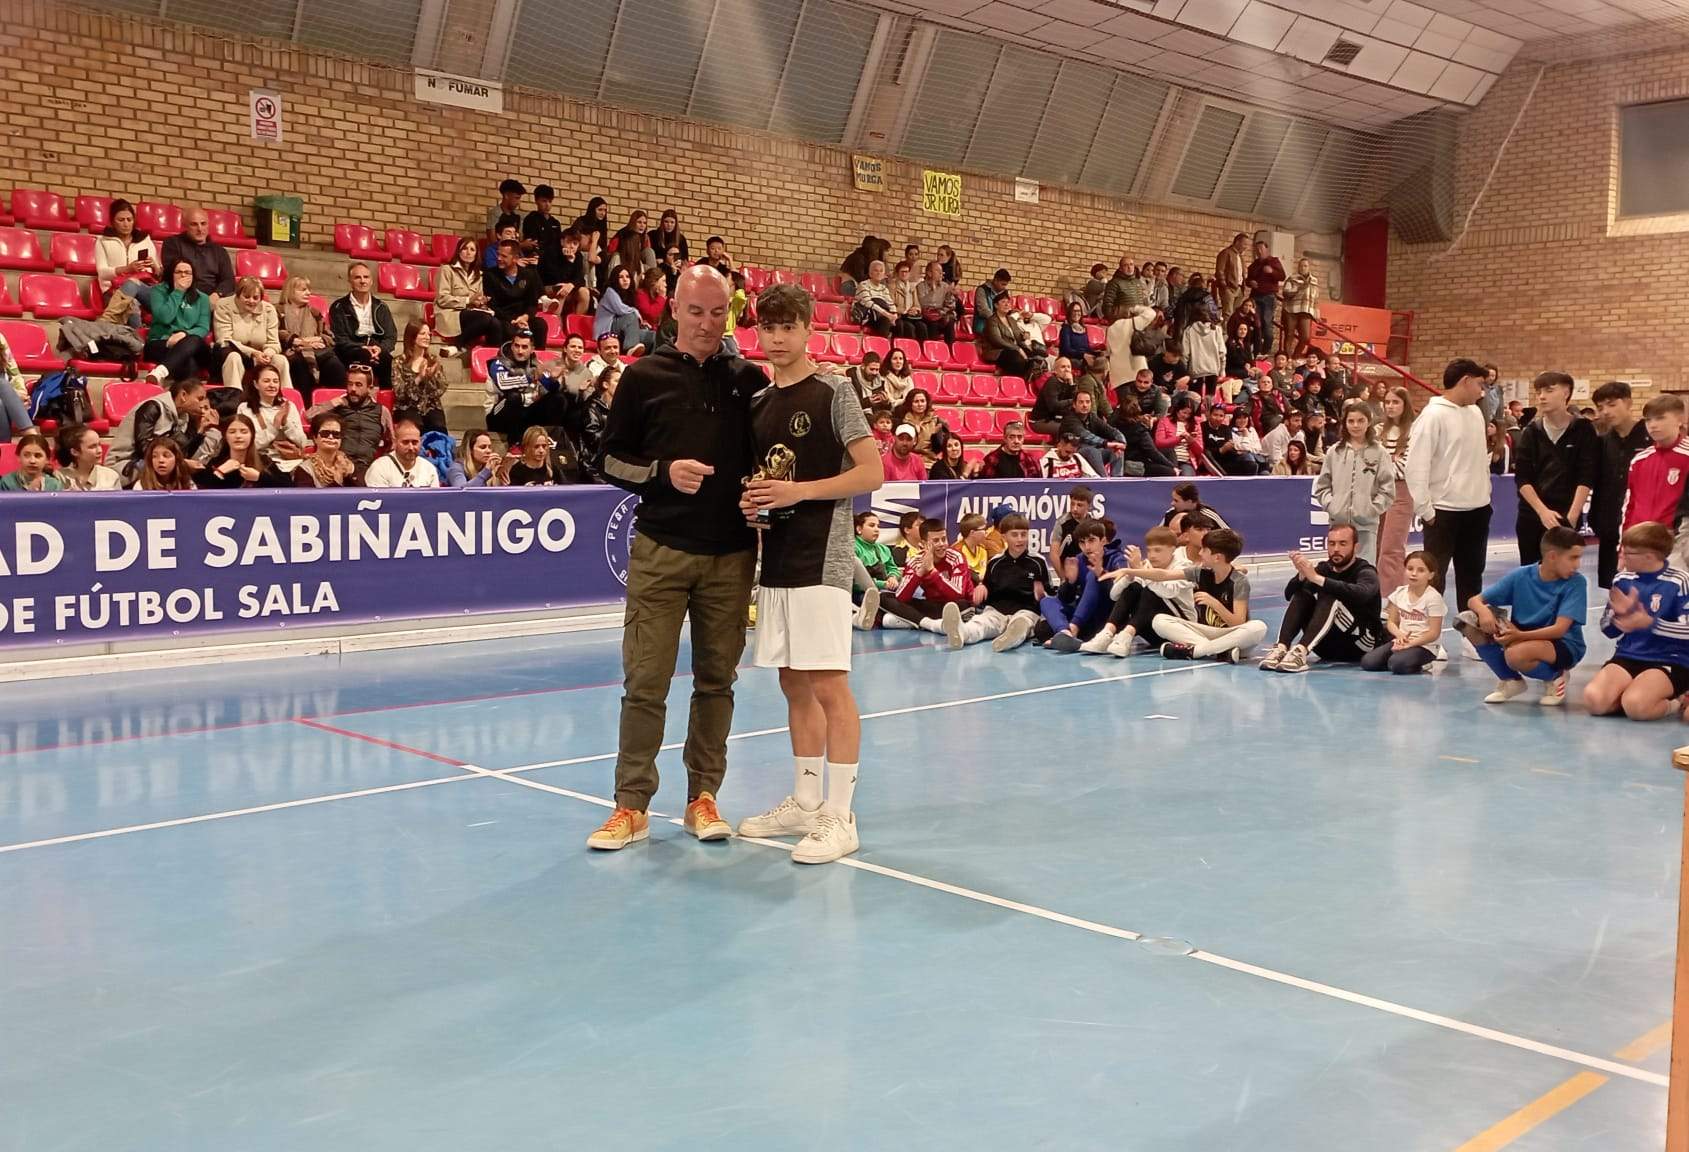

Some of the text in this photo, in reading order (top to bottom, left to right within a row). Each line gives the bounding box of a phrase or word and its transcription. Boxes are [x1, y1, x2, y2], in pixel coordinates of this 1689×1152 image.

[448, 81, 489, 97] FUMAR
[855, 160, 882, 172] VAMOS
[925, 175, 959, 197] VAMOS
[94, 518, 177, 572] DE
[203, 499, 576, 568] SABIÑANIGO
[54, 582, 223, 631] FÚTBOL
[238, 581, 341, 618] SALA
